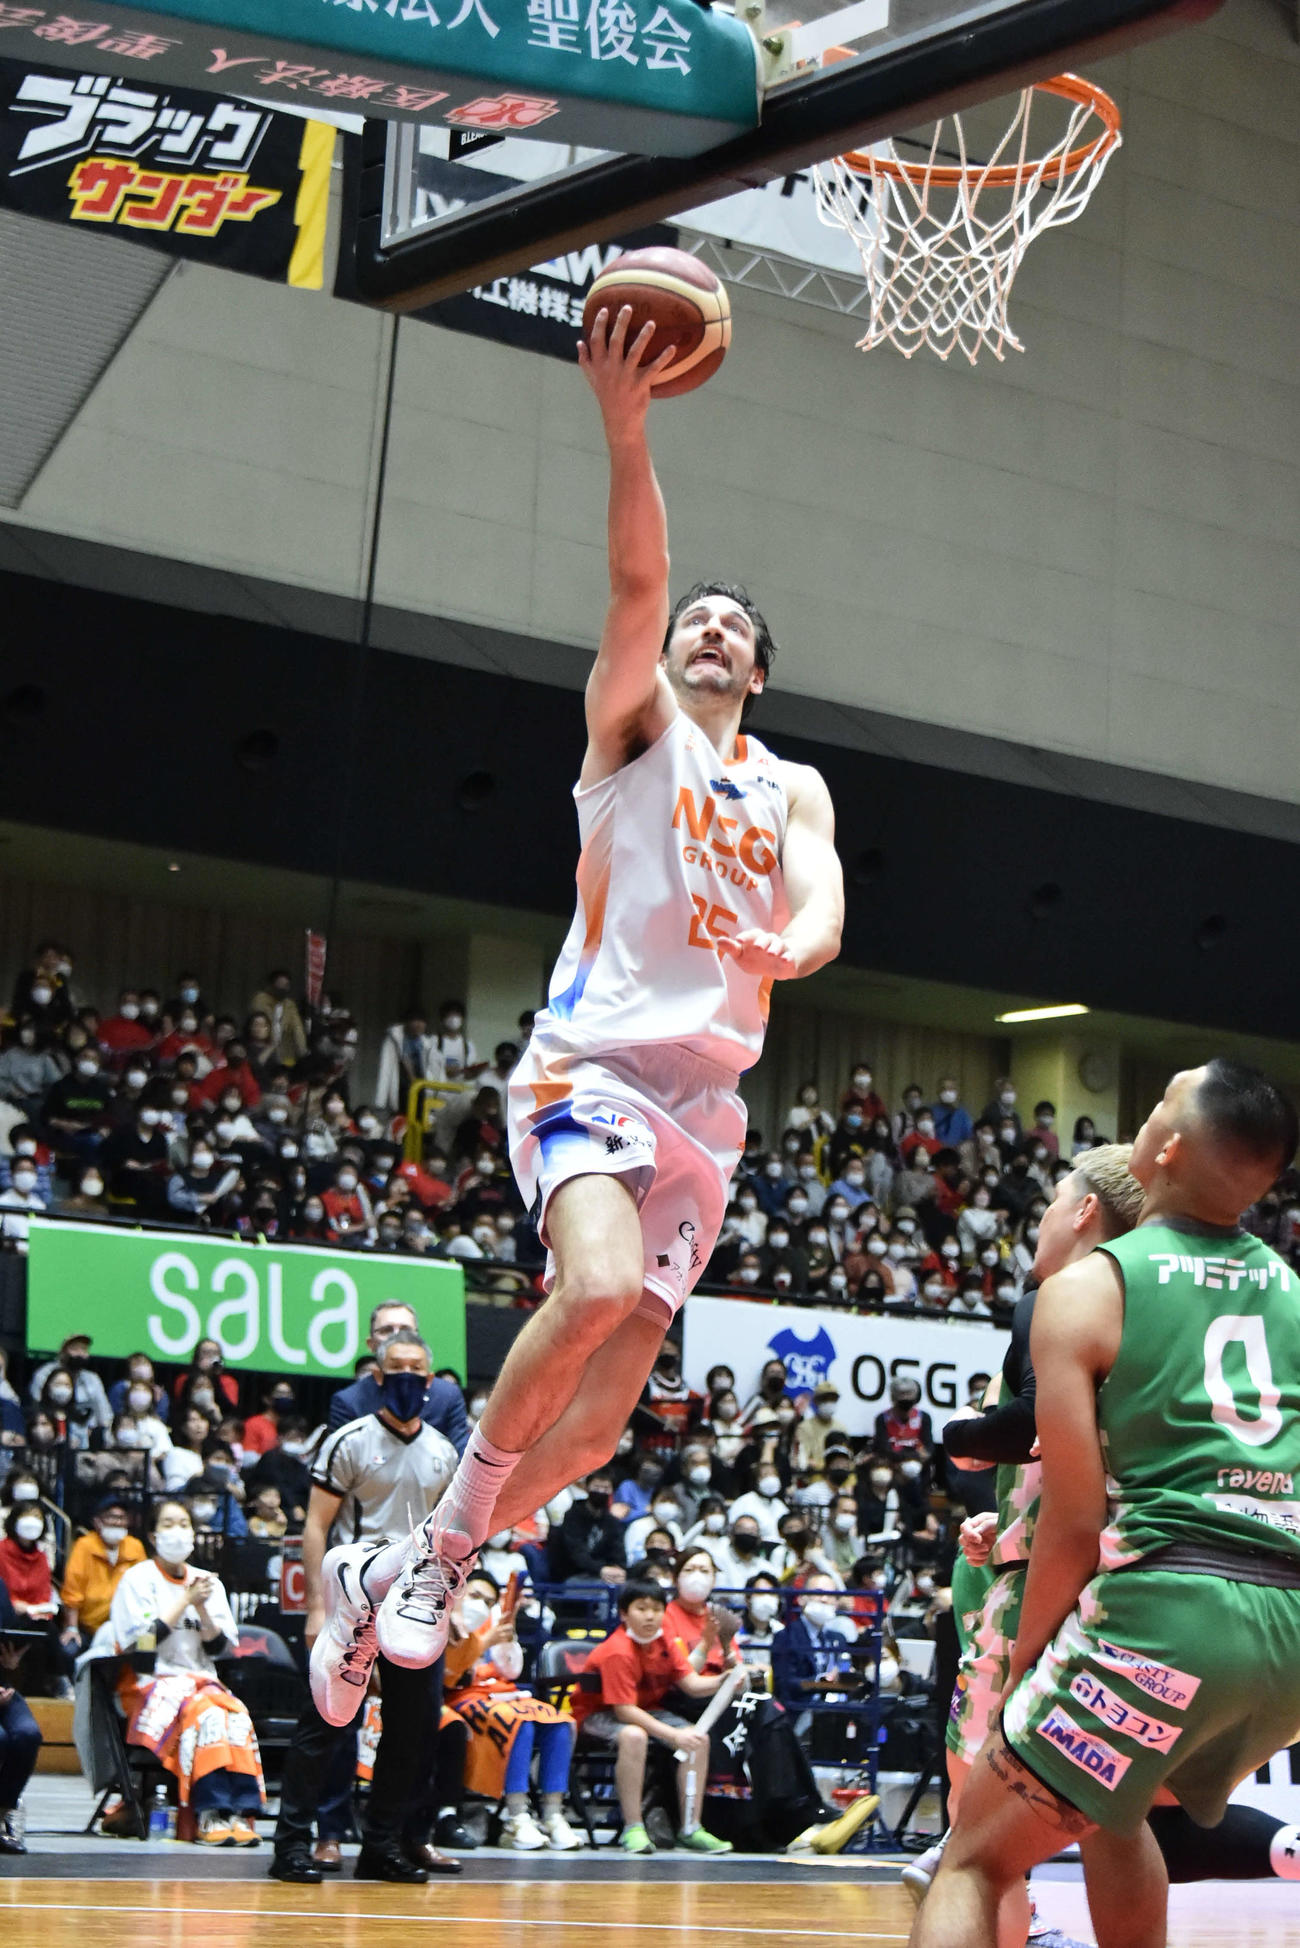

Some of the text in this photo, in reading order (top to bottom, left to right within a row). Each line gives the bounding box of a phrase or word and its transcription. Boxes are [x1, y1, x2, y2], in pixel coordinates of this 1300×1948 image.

[527, 0, 692, 76] 聖俊会
[10, 74, 272, 176] ブラック
[67, 157, 282, 237] サンダー
[672, 786, 777, 875] NSG
[682, 846, 759, 891] GROUP
[148, 1251, 359, 1368] sala
[1148, 1253, 1290, 1292] アツミテック
[1203, 1315, 1283, 1446] 0
[1134, 1672, 1187, 1703] GROUP
[1041, 1717, 1117, 1784] IMADA
